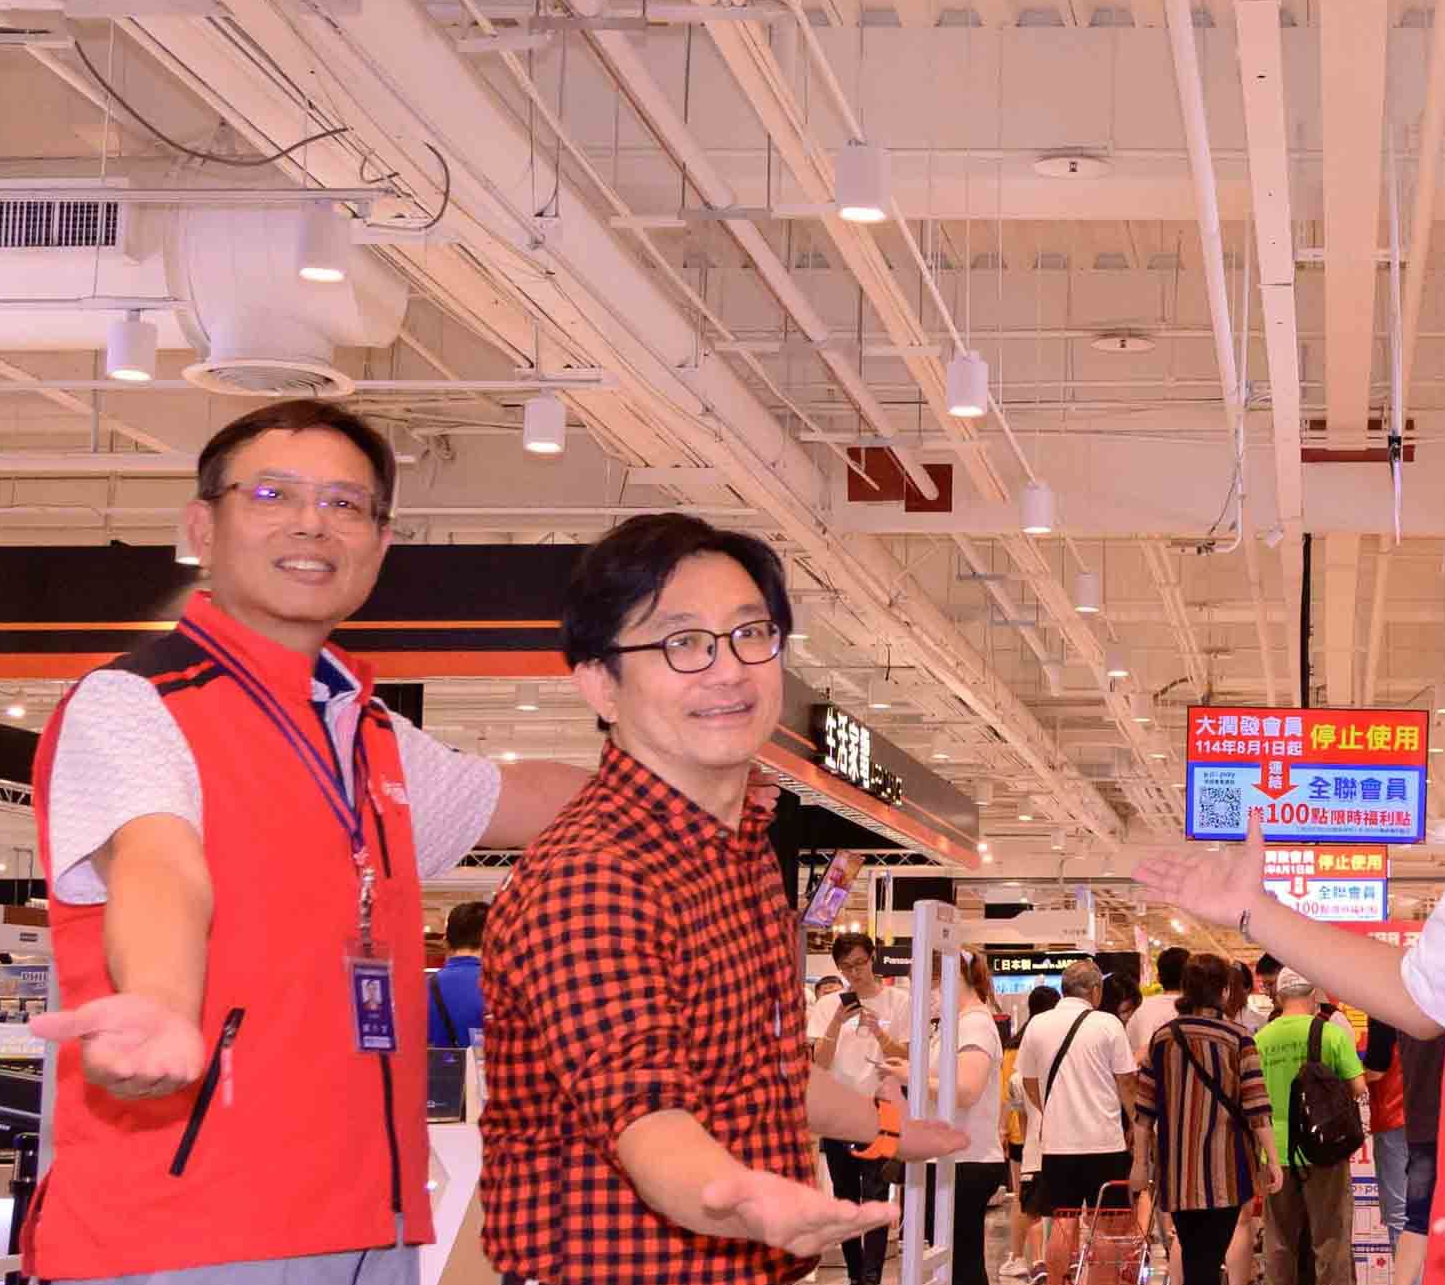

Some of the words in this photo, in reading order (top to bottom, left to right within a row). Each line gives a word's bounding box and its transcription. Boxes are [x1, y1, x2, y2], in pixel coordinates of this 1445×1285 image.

[1195, 715, 1303, 737] 大潤發會員
[1310, 724, 1419, 751] 停止使用
[1195, 740, 1303, 756] 114年8月1日起
[1308, 776, 1408, 801] 全聯會員
